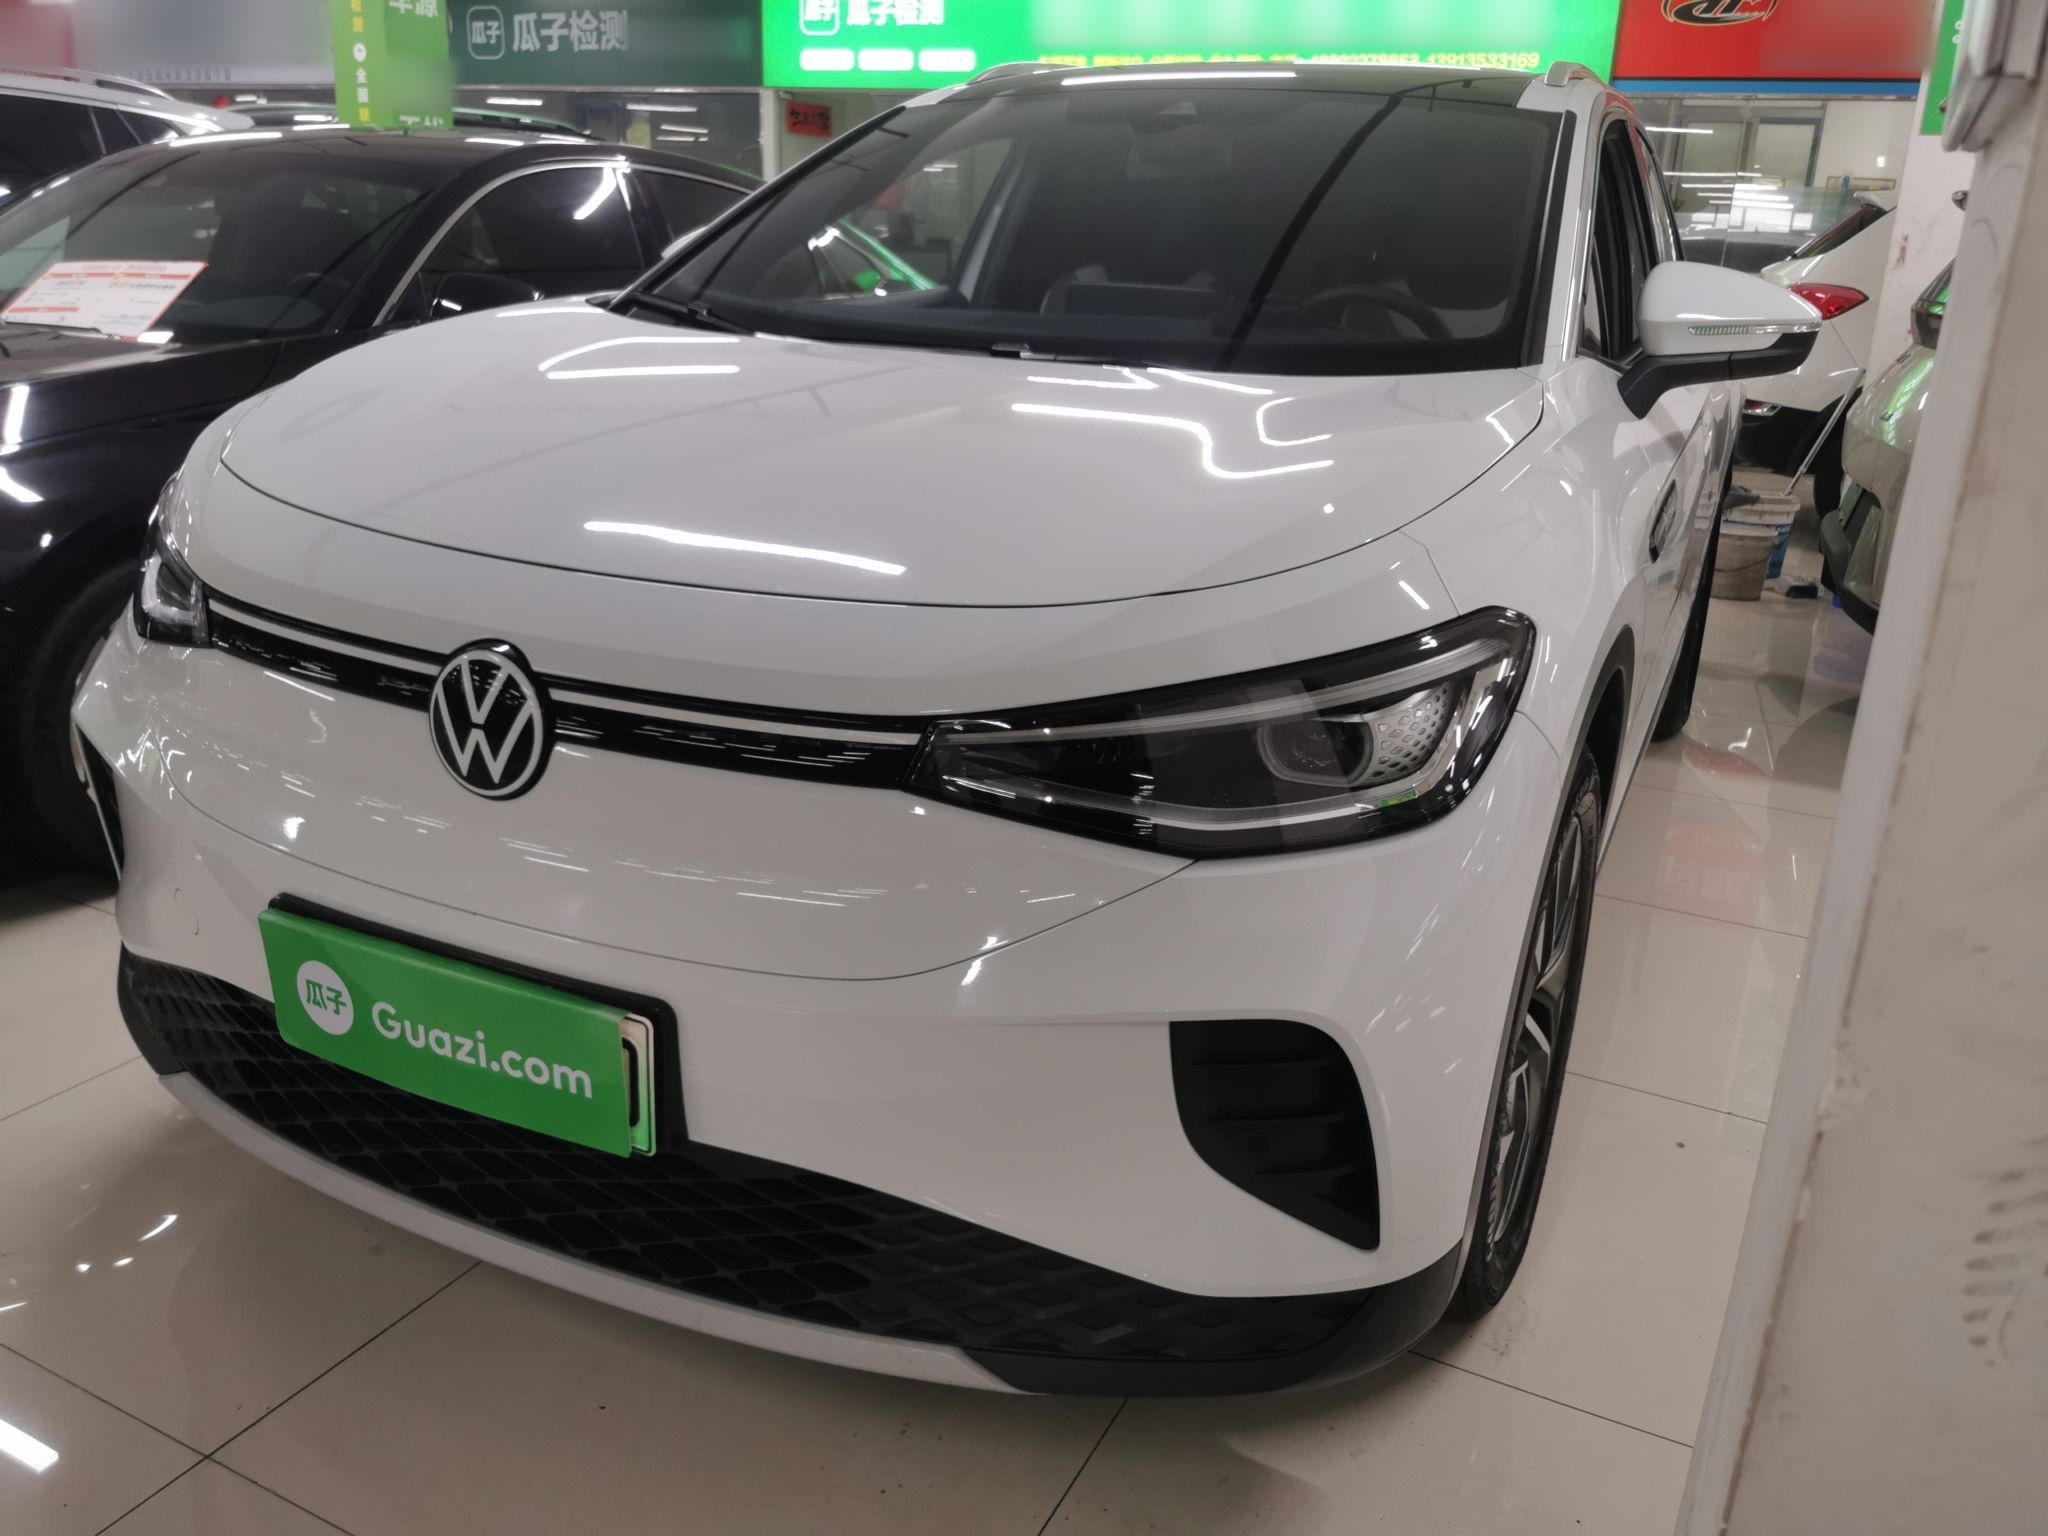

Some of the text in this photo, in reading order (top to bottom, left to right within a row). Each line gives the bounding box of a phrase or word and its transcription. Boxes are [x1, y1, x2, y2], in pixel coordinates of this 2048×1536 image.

[471, 10, 629, 52] 瓜子 瓜子检测
[304, 978, 593, 1099] 瓜子 Guazi.com
